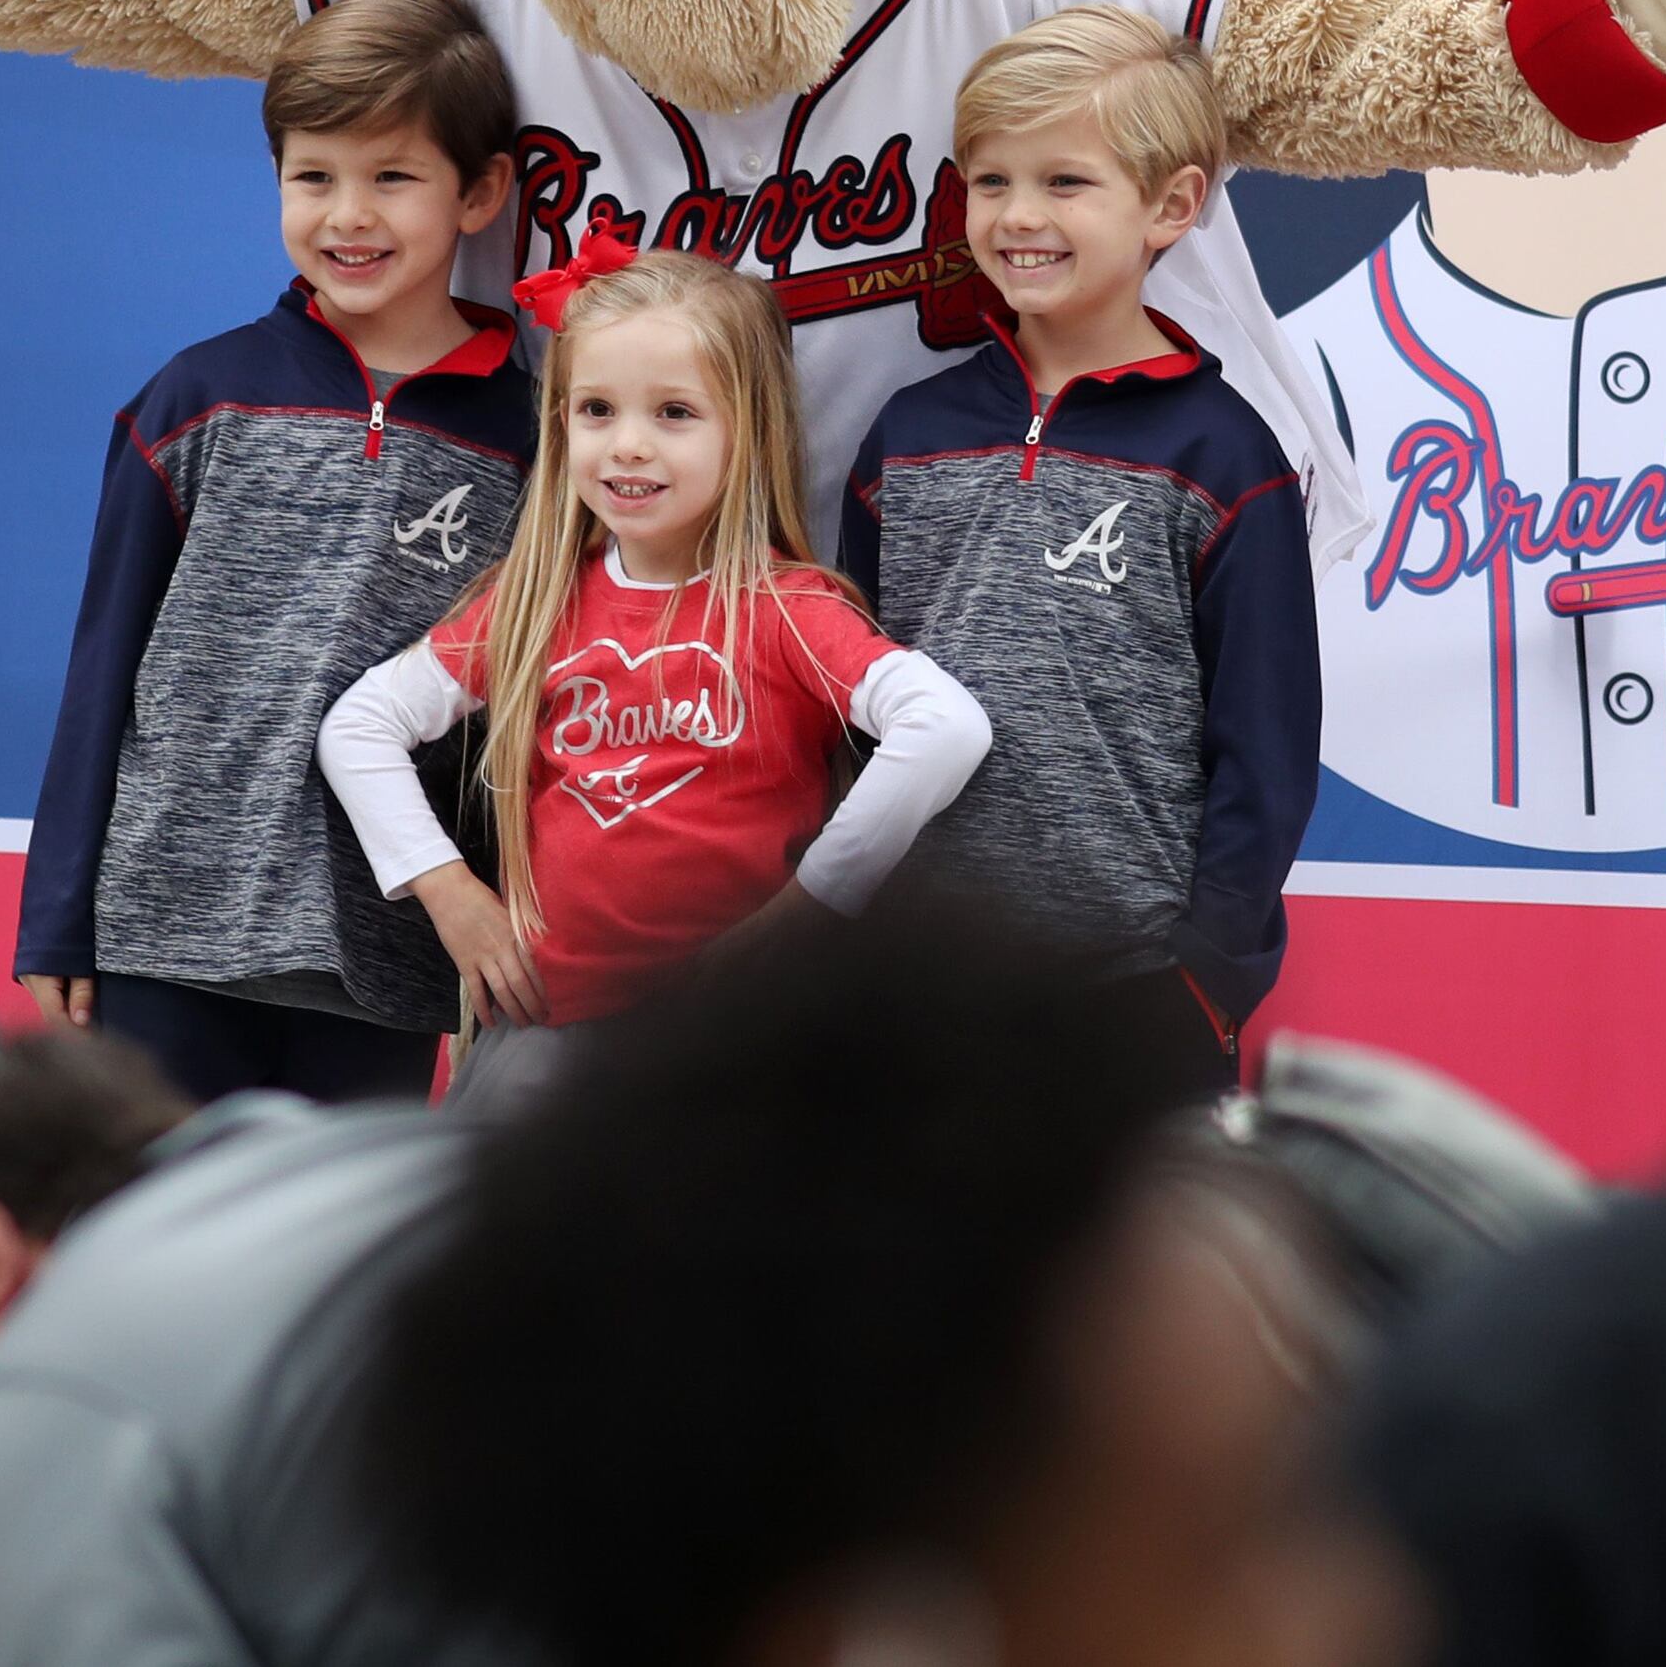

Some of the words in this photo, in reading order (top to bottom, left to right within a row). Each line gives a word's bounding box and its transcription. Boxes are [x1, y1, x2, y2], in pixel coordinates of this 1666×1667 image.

[393, 483, 474, 564] A
[1044, 500, 1130, 584] A
[552, 674, 733, 756] Braves
